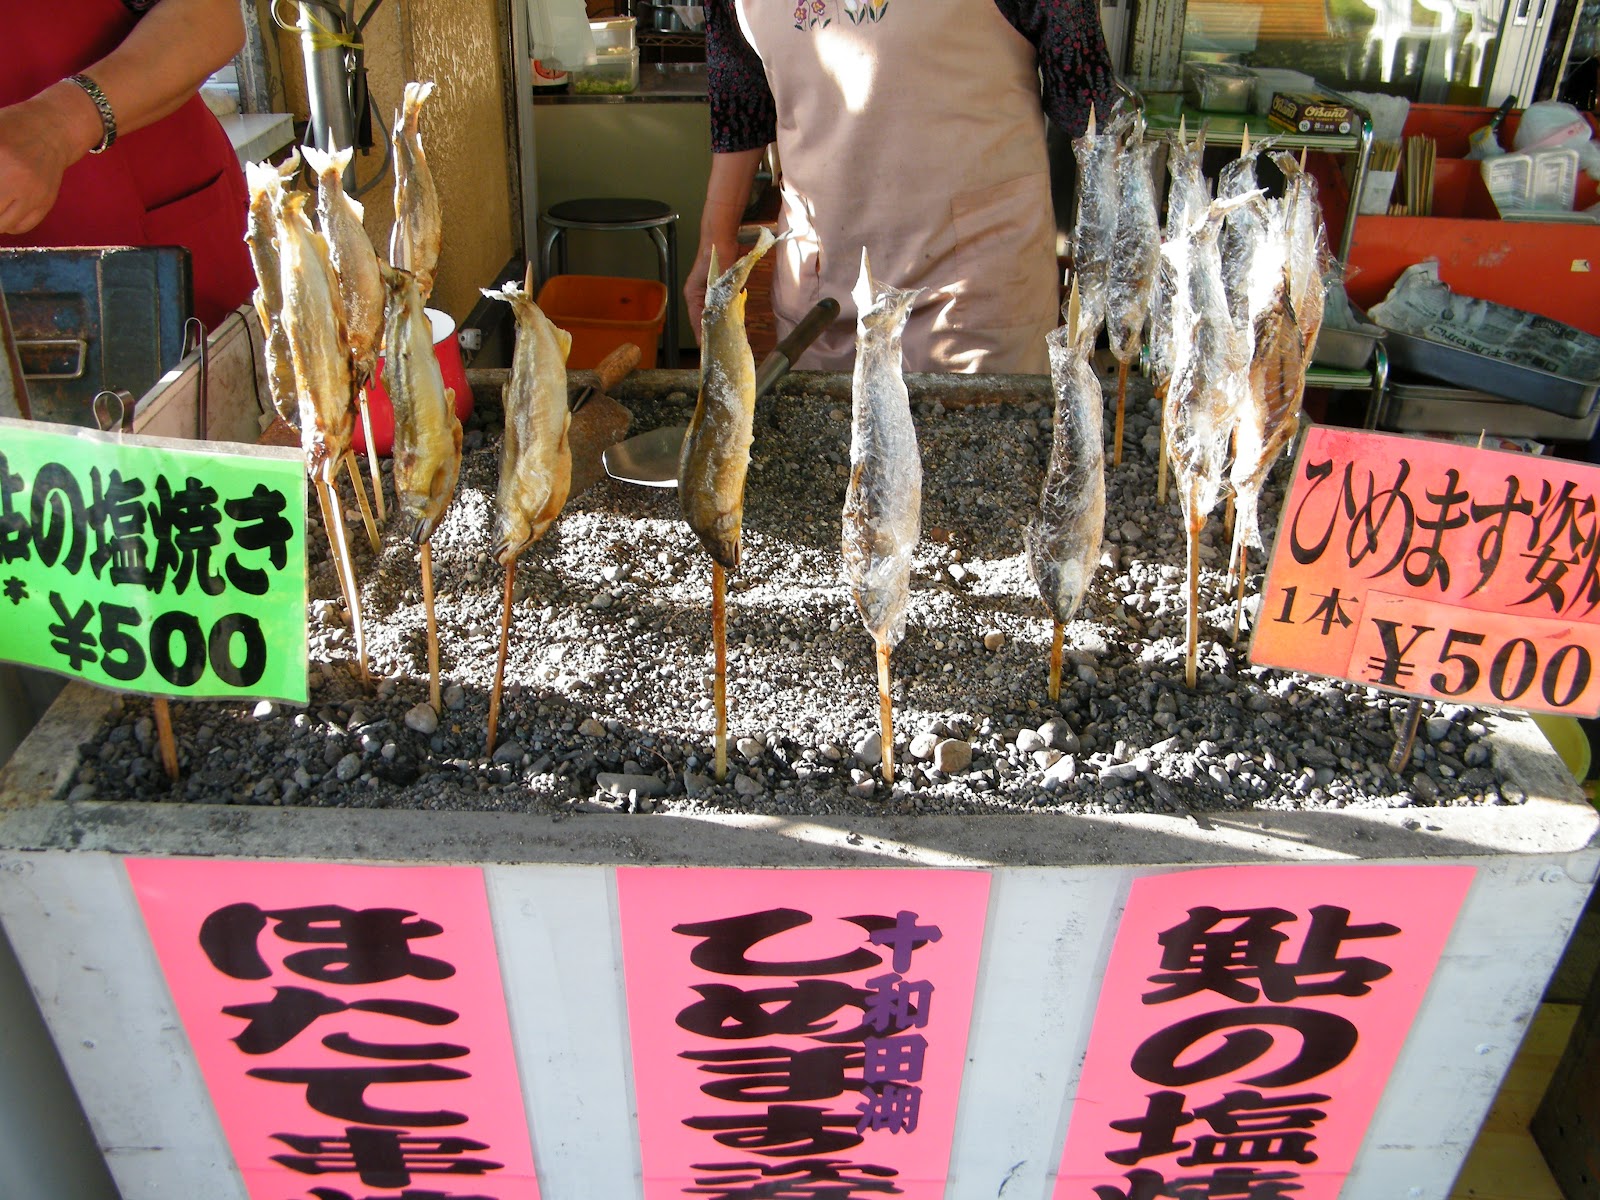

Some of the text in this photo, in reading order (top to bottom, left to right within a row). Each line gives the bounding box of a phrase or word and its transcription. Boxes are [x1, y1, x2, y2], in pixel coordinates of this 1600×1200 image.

[49, 590, 266, 687] ¥500
[1273, 586, 1359, 635] 1本
[1367, 618, 1592, 706] ¥500
[199, 902, 505, 1200] ほたて串
[855, 910, 943, 1135] 十和田湖
